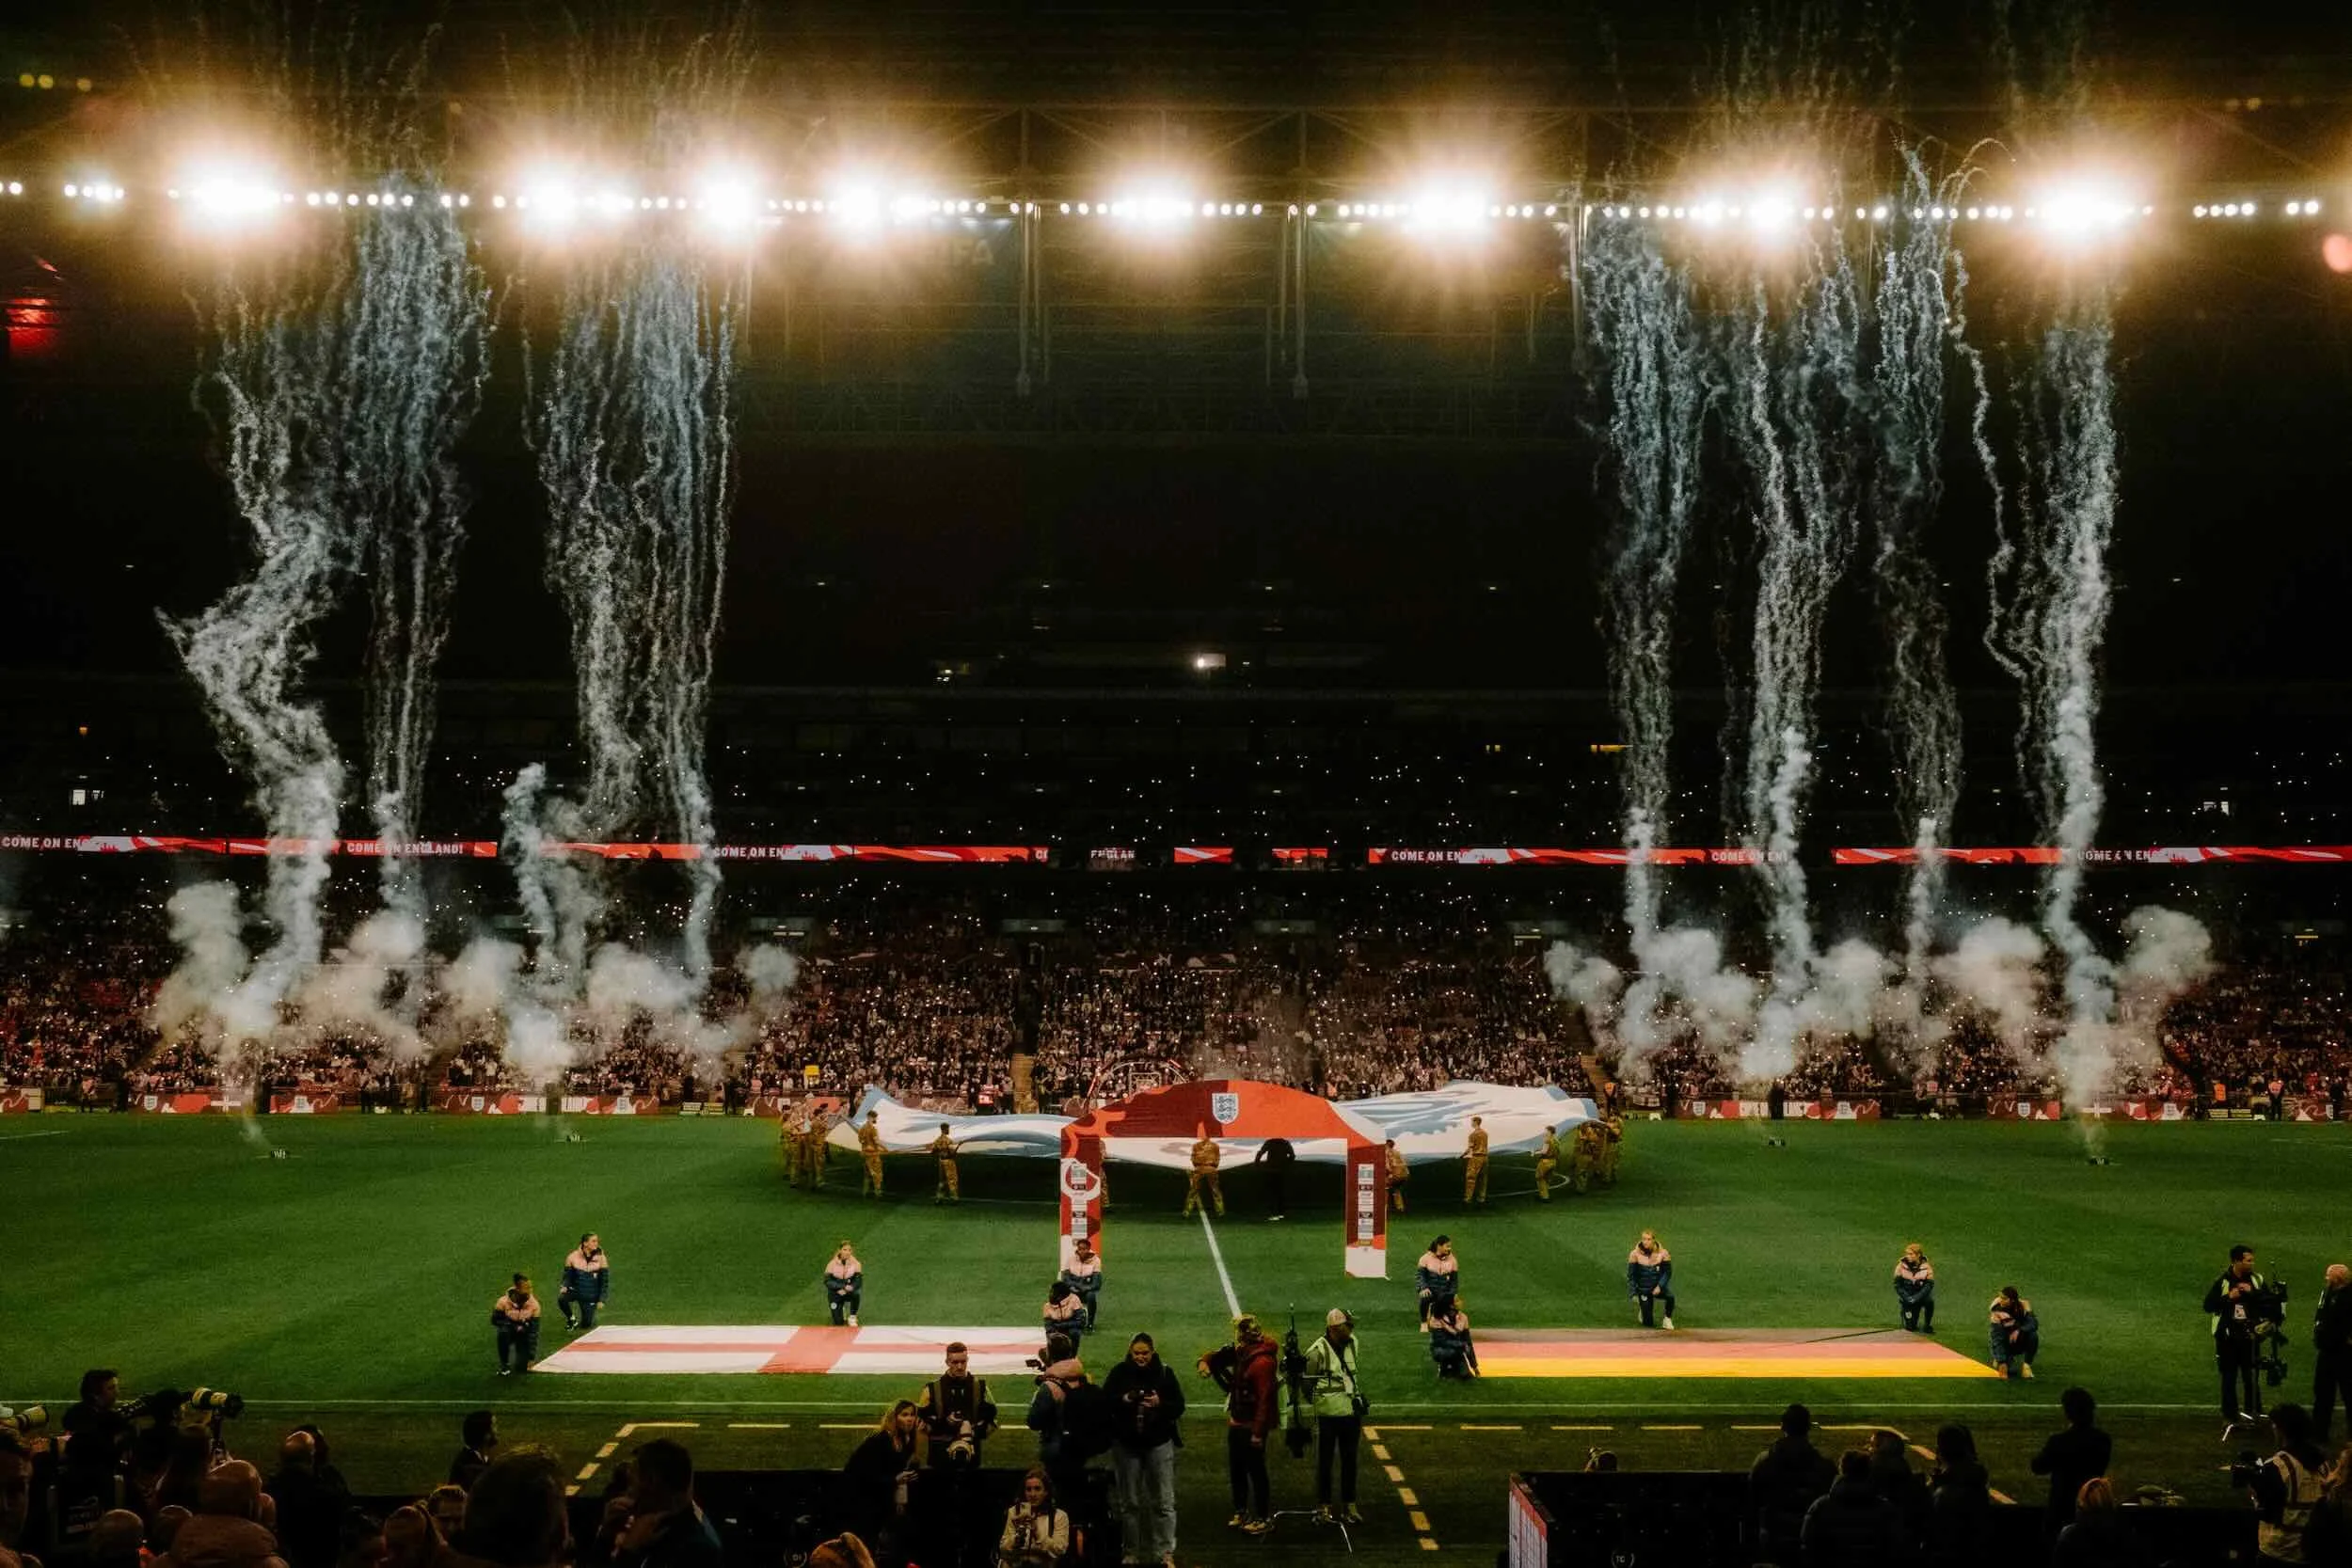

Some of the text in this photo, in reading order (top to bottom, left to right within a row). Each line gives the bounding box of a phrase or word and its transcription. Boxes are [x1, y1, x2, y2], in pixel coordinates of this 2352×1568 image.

[2, 836, 39, 847] COME
[43, 837, 60, 847] ON
[347, 842, 381, 852] COME
[714, 847, 747, 857] COME
[750, 847, 766, 857] ON
[1391, 850, 1423, 861] COME
[1427, 851, 1443, 861] ON
[1712, 851, 1744, 862] COME
